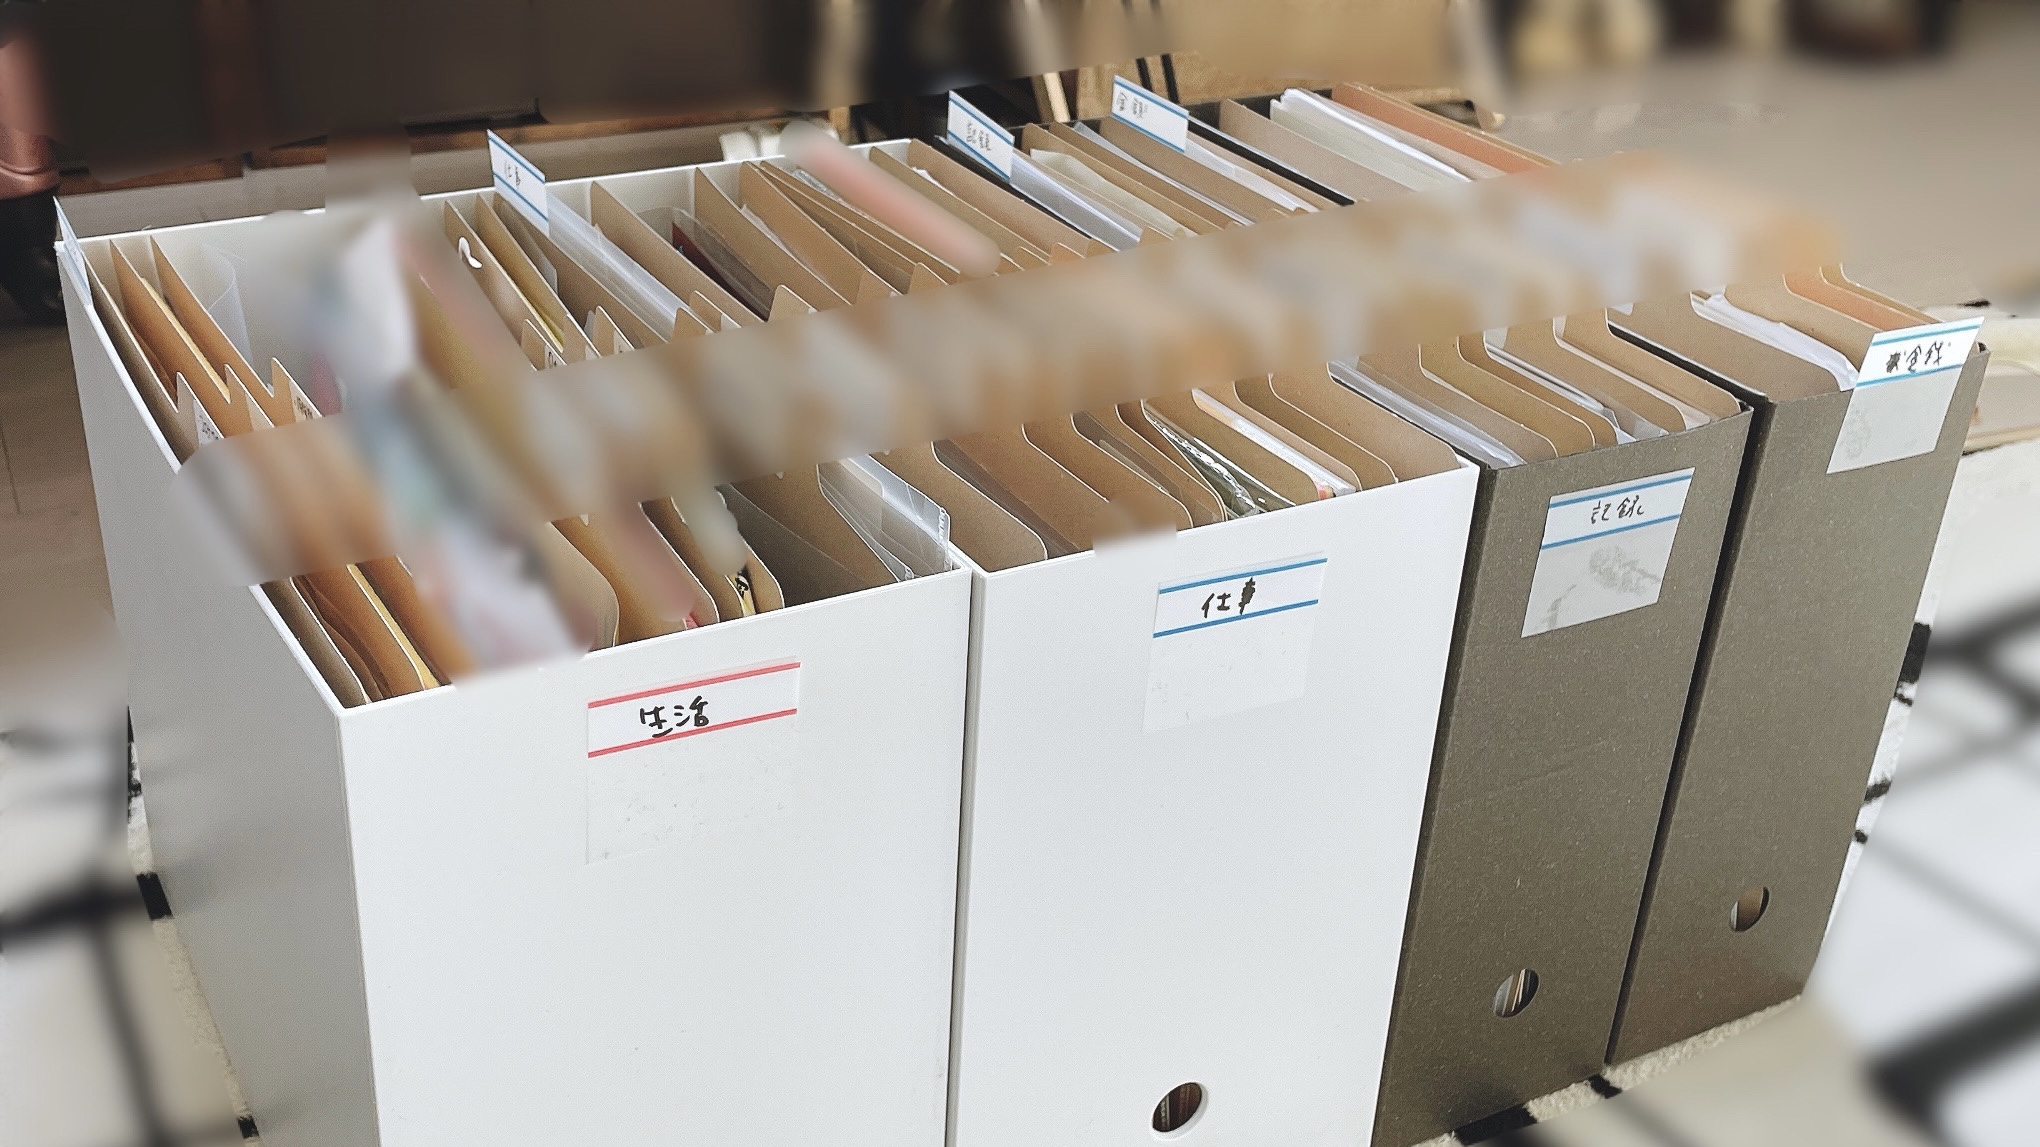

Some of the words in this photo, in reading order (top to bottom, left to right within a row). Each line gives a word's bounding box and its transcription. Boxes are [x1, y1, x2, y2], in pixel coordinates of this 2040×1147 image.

[1591, 494, 1645, 525] 記録
[1201, 577, 1257, 619] 仕事
[639, 695, 710, 739] 生活
